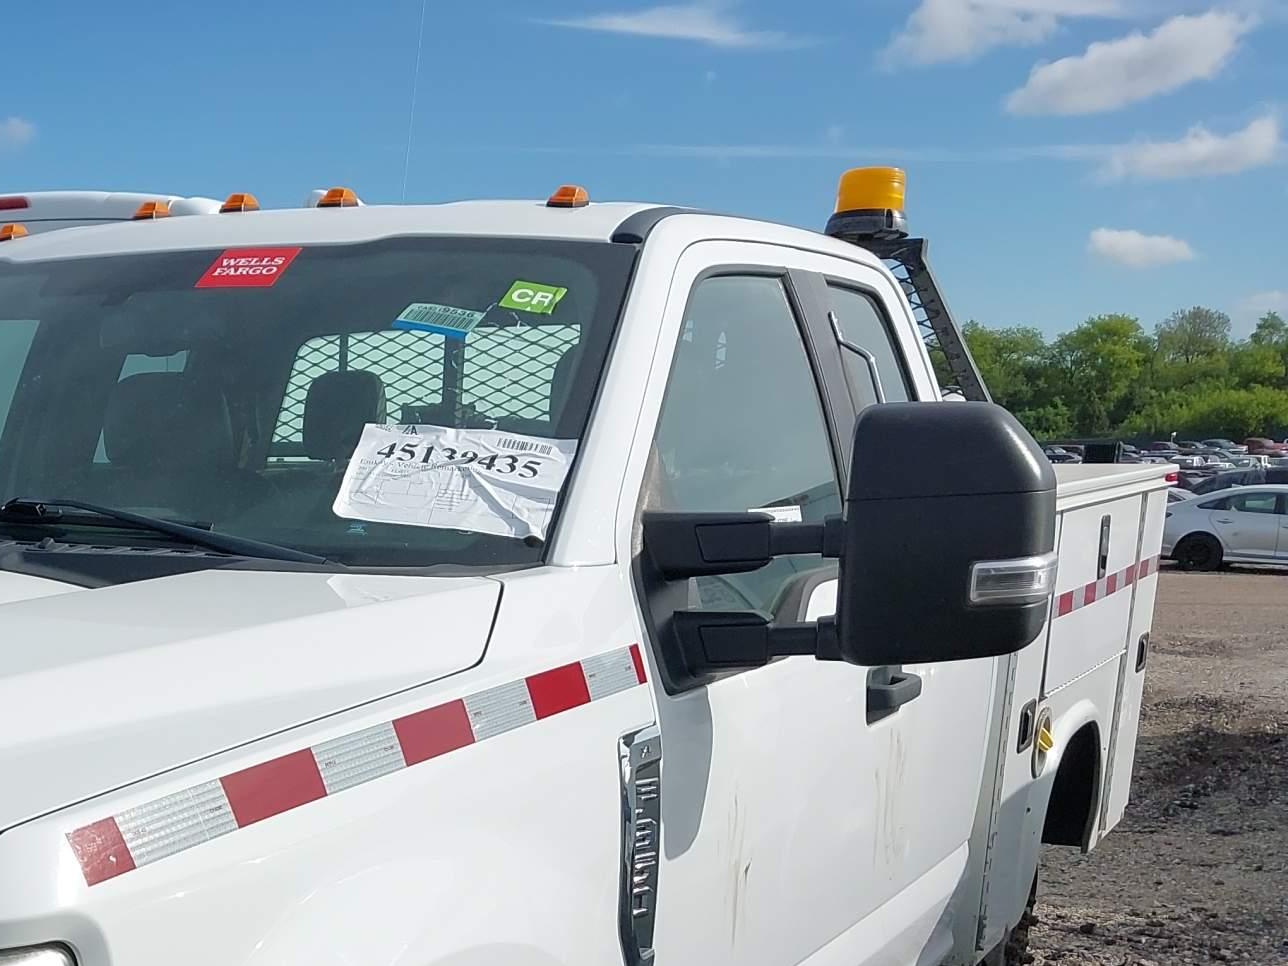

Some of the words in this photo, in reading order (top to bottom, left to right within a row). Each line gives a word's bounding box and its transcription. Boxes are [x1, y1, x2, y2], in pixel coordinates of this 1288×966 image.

[221, 256, 286, 266] WELLS
[212, 266, 278, 276] FARGO
[512, 288, 554, 306] CR
[376, 442, 542, 480] 45139435
